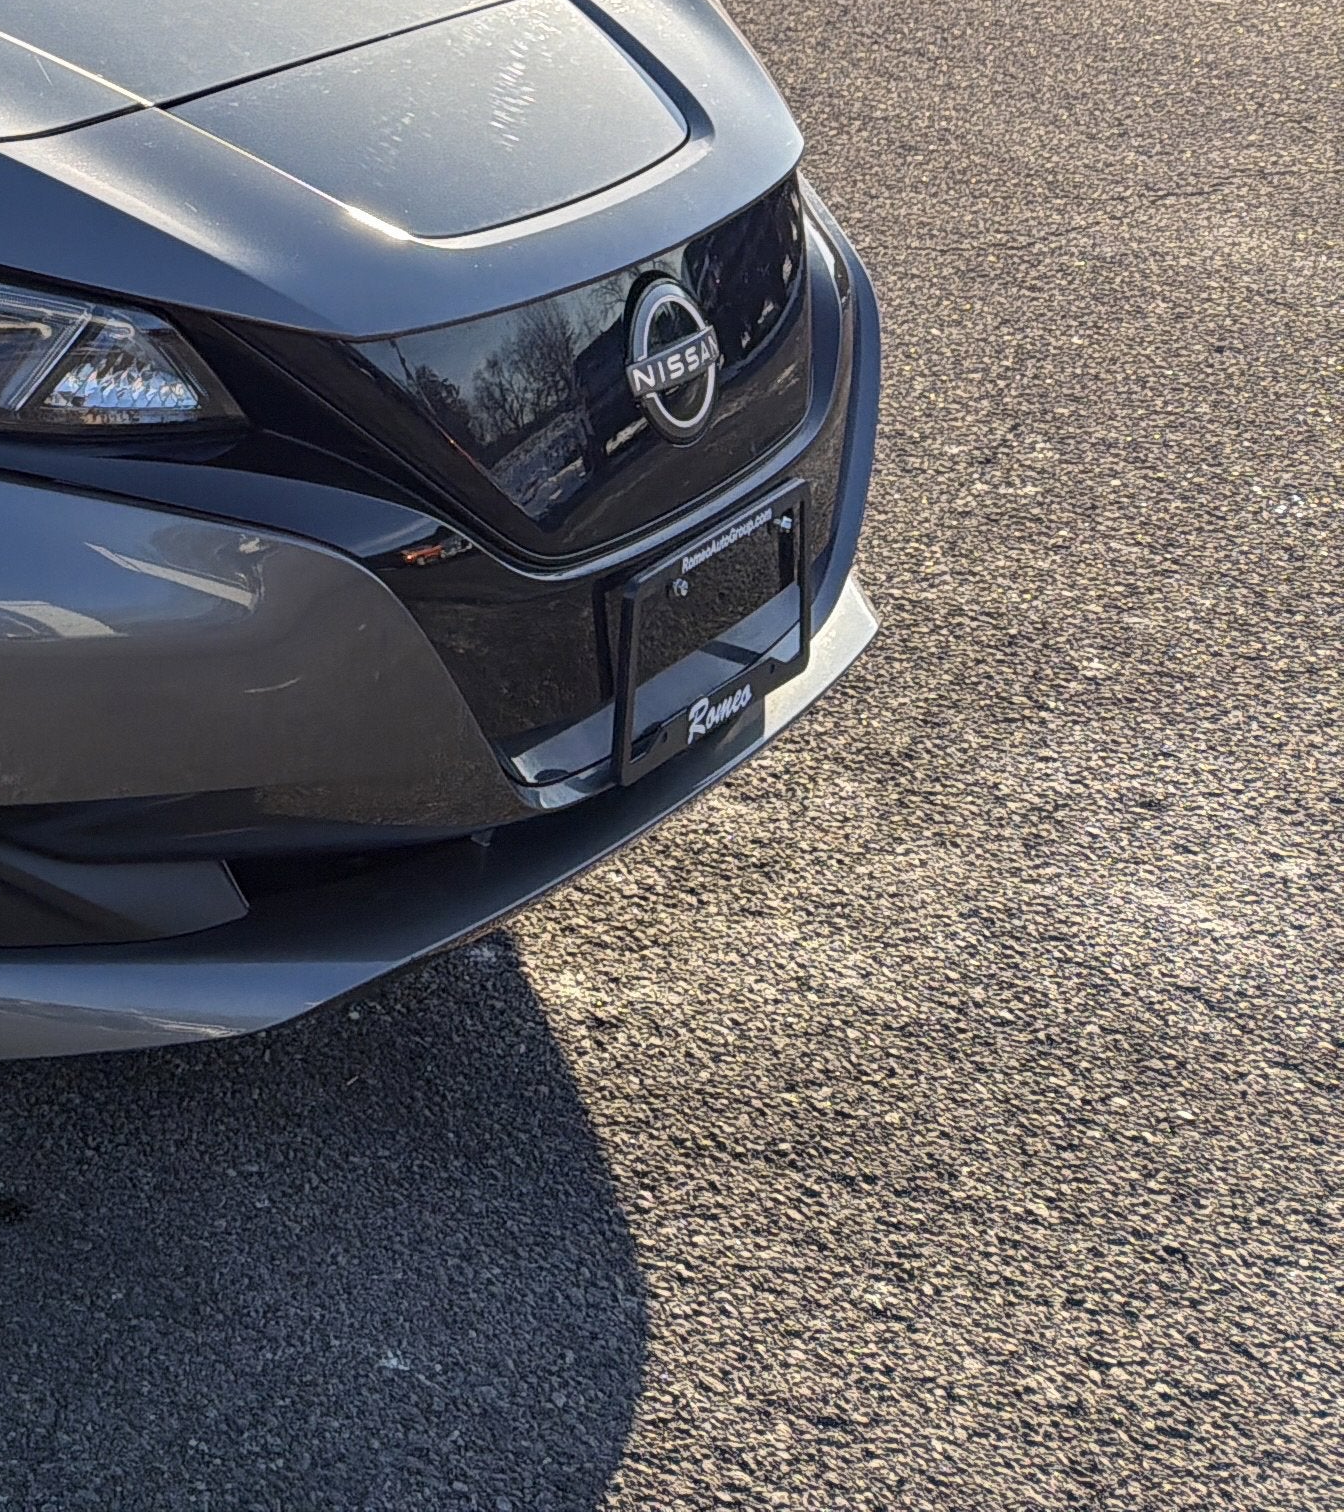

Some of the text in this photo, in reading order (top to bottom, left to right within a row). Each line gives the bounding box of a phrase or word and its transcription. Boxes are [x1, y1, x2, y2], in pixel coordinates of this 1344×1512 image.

[632, 334, 719, 392] NISSAN
[681, 507, 772, 575] RomeoAutoGroup.com
[687, 683, 752, 745] Romeo
